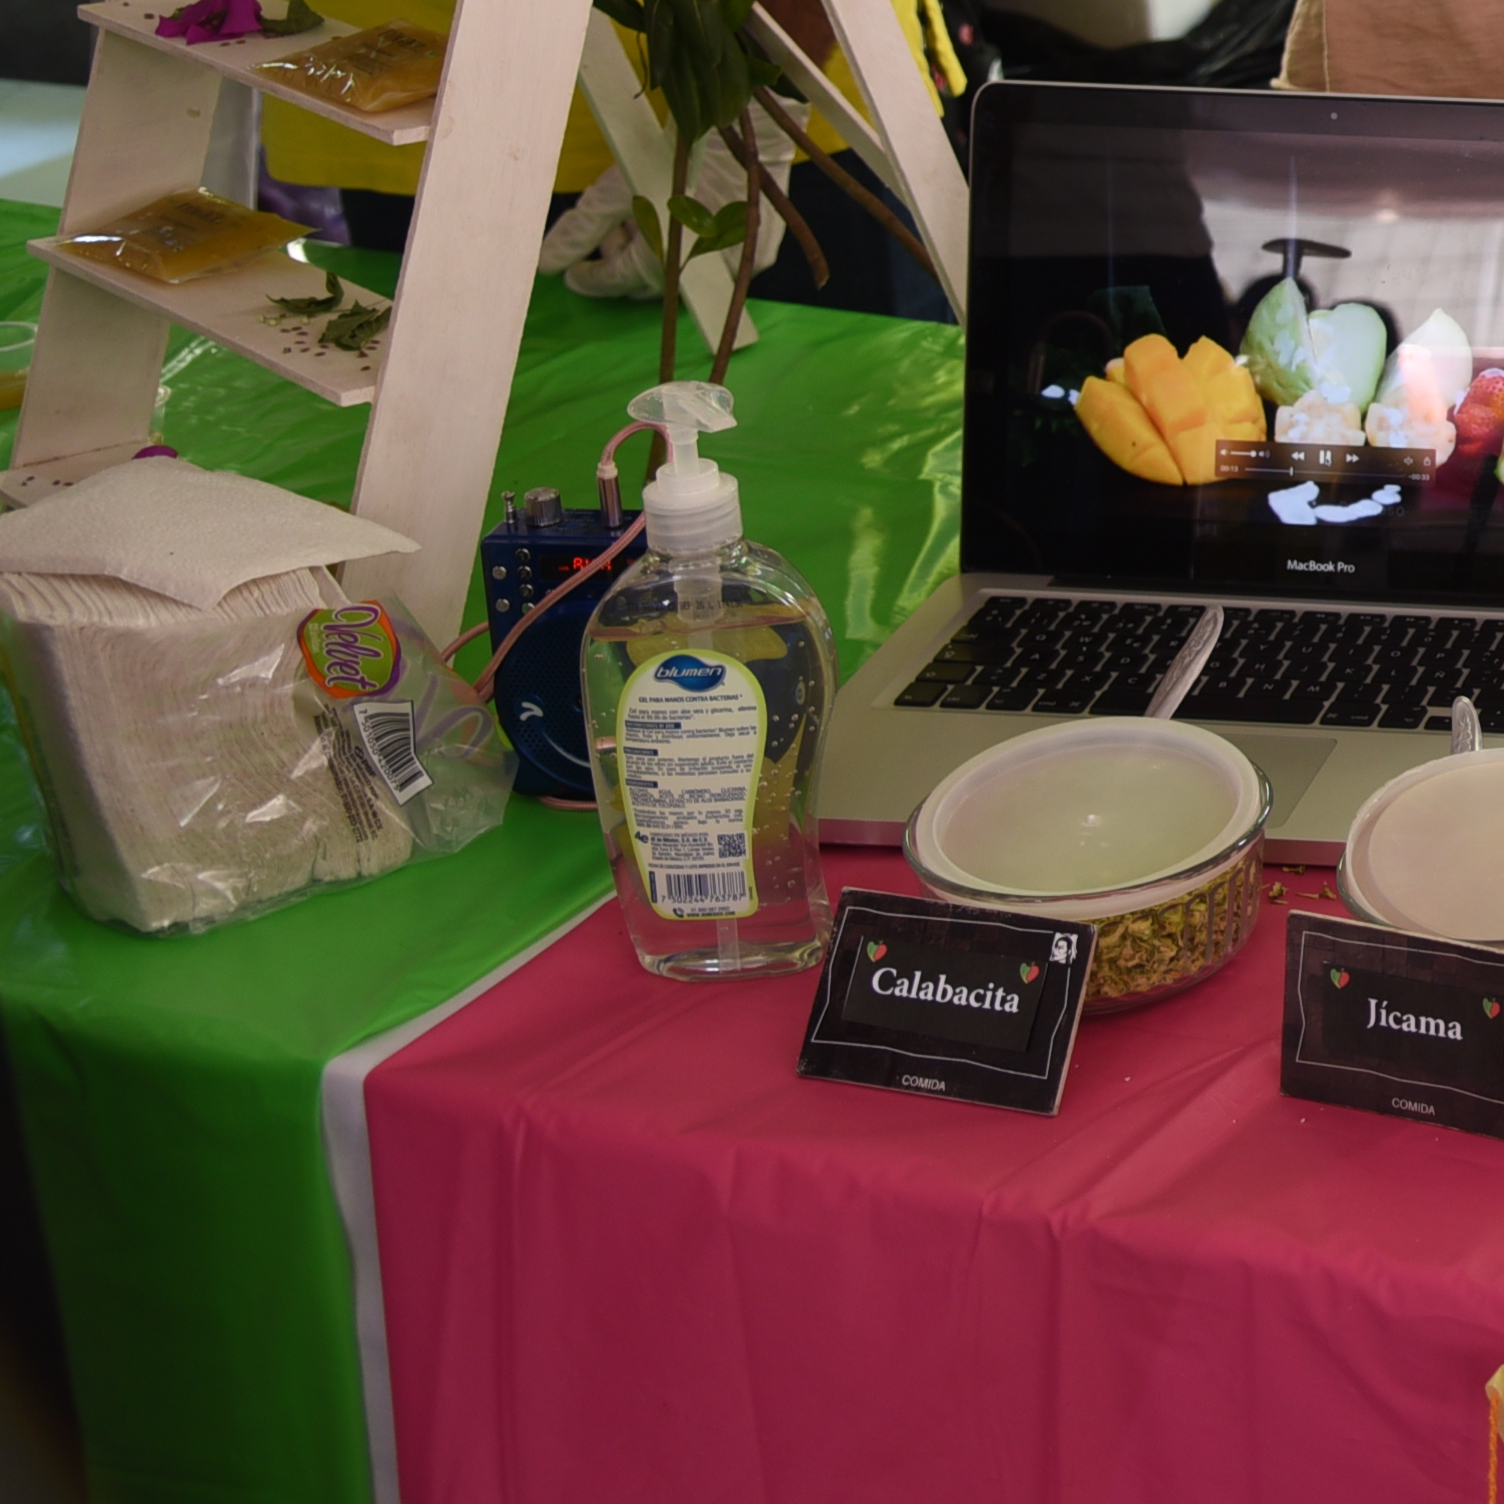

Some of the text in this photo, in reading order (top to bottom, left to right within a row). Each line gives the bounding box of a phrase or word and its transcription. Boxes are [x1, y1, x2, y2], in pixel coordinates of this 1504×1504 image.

[1287, 559, 1356, 574] MacBook Pro
[322, 605, 384, 690] Velvet
[656, 666, 722, 679] blumen
[871, 967, 1020, 1014] Calabacita
[1366, 998, 1464, 1041] Jícama
[901, 1074, 946, 1092] COMIDA
[1391, 1097, 1436, 1116] COMIDA
